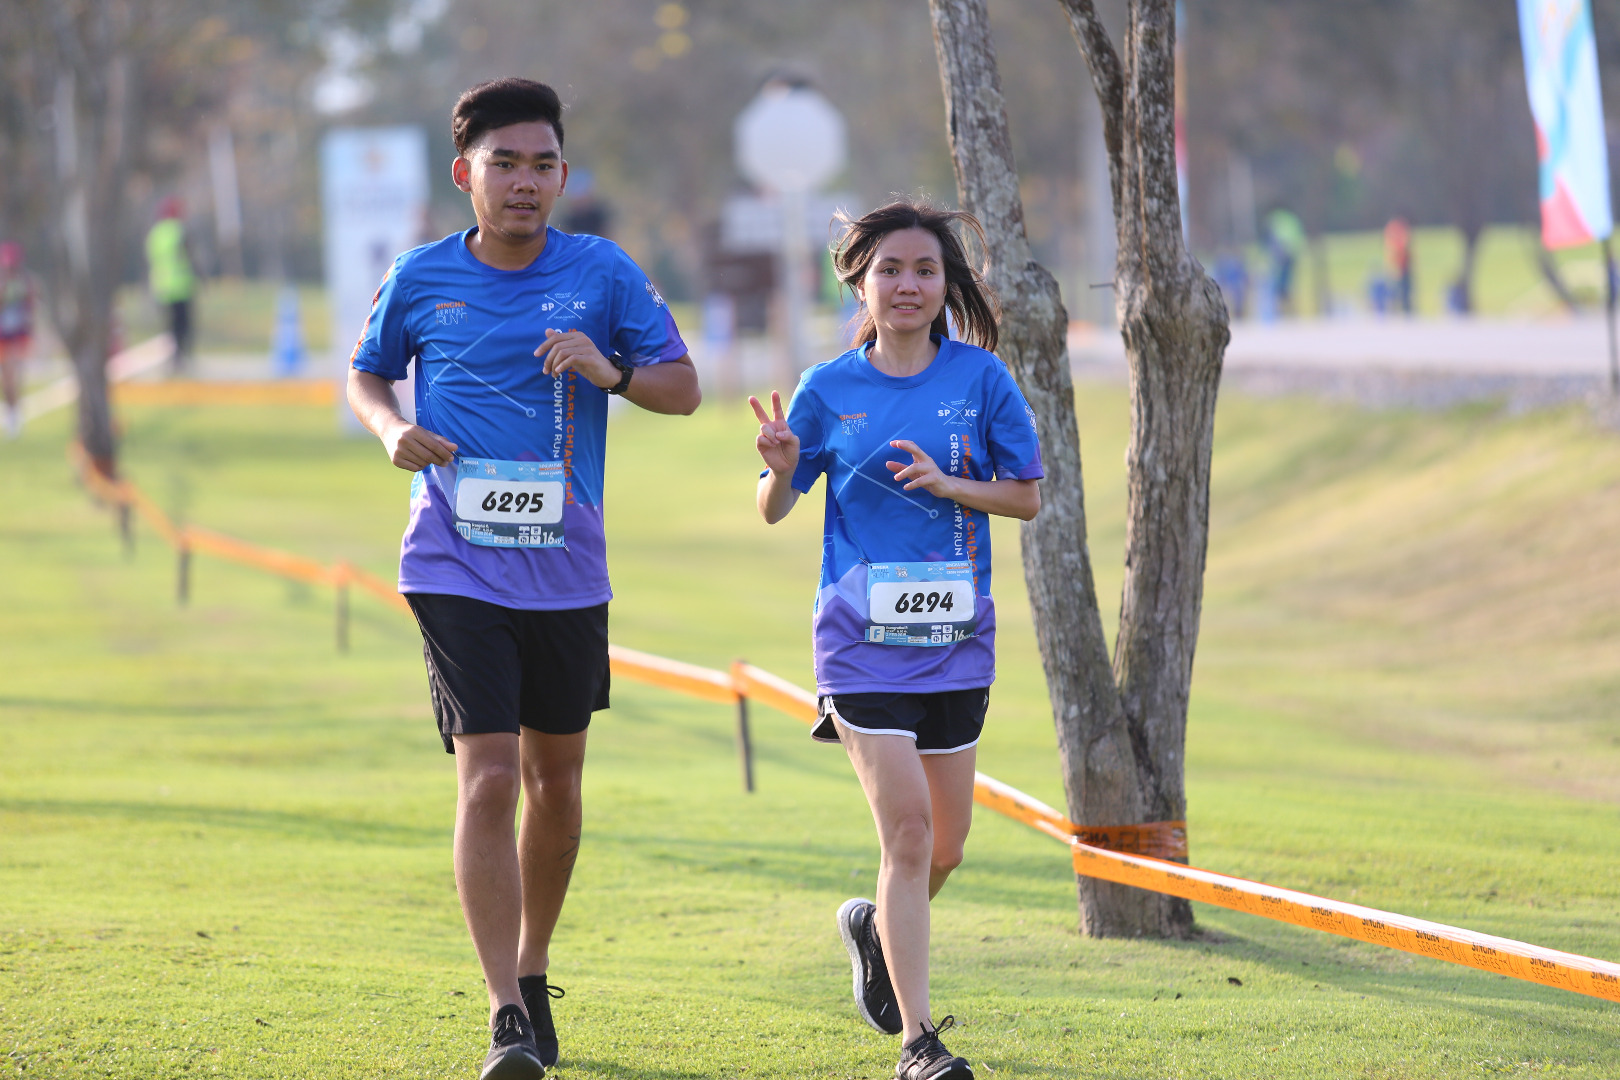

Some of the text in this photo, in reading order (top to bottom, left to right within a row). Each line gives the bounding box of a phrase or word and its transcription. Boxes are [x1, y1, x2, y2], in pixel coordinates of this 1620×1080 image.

[435, 301, 467, 310] SINGHA
[541, 300, 587, 312] SP XC
[565, 385, 576, 421] PARK
[937, 409, 978, 417] SP XC
[552, 434, 563, 458] RUN
[563, 424, 575, 478] CHIANG
[949, 433, 960, 473] CROSS
[481, 491, 544, 513] 6295
[565, 482, 575, 505] RAI
[543, 531, 554, 545] 16
[953, 532, 963, 556] RUN
[895, 592, 954, 614] 6294
[873, 628, 881, 639] F
[954, 629, 965, 641] 16
